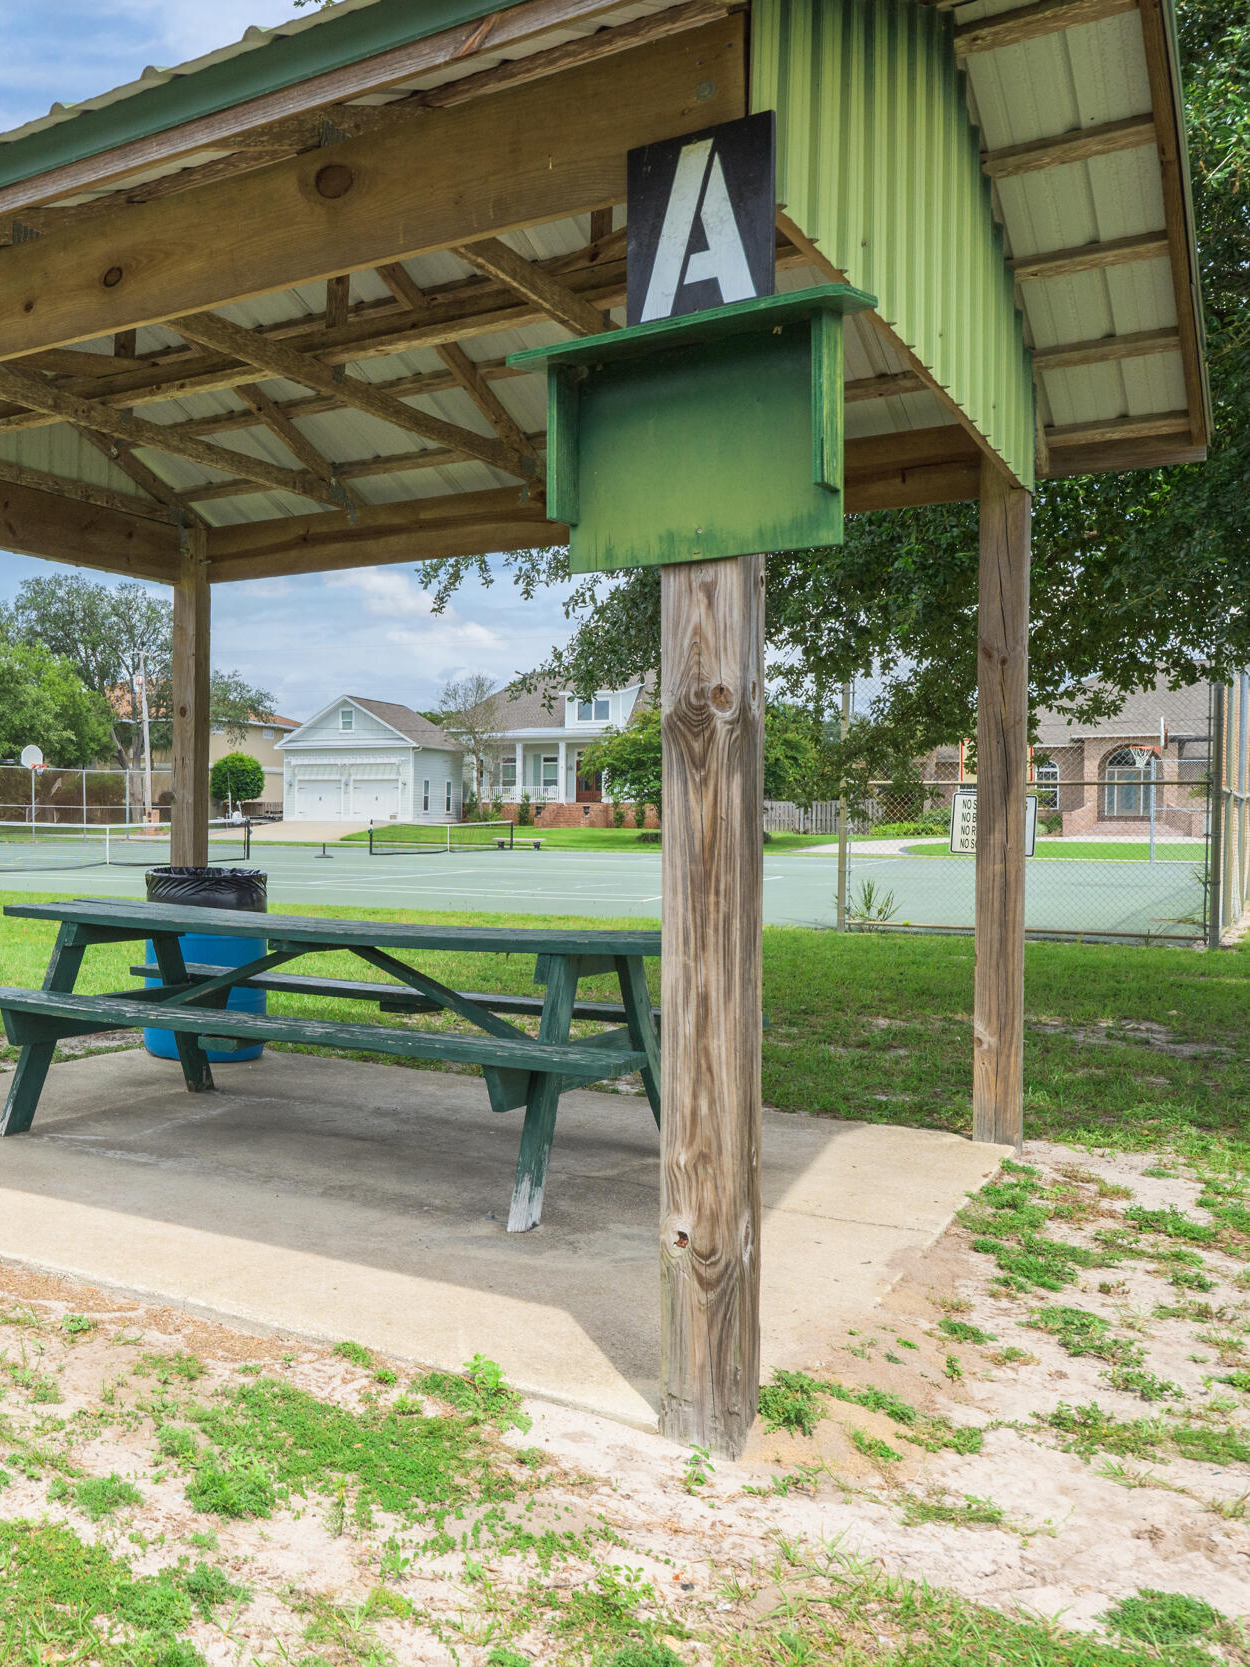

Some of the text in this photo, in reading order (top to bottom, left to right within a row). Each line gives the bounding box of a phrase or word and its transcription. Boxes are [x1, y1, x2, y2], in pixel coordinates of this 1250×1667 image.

[640, 137, 757, 323] A
[962, 799, 972, 809] NO
[961, 812, 971, 822] NO
[961, 825, 970, 835] NO
[960, 838, 969, 848] NO
